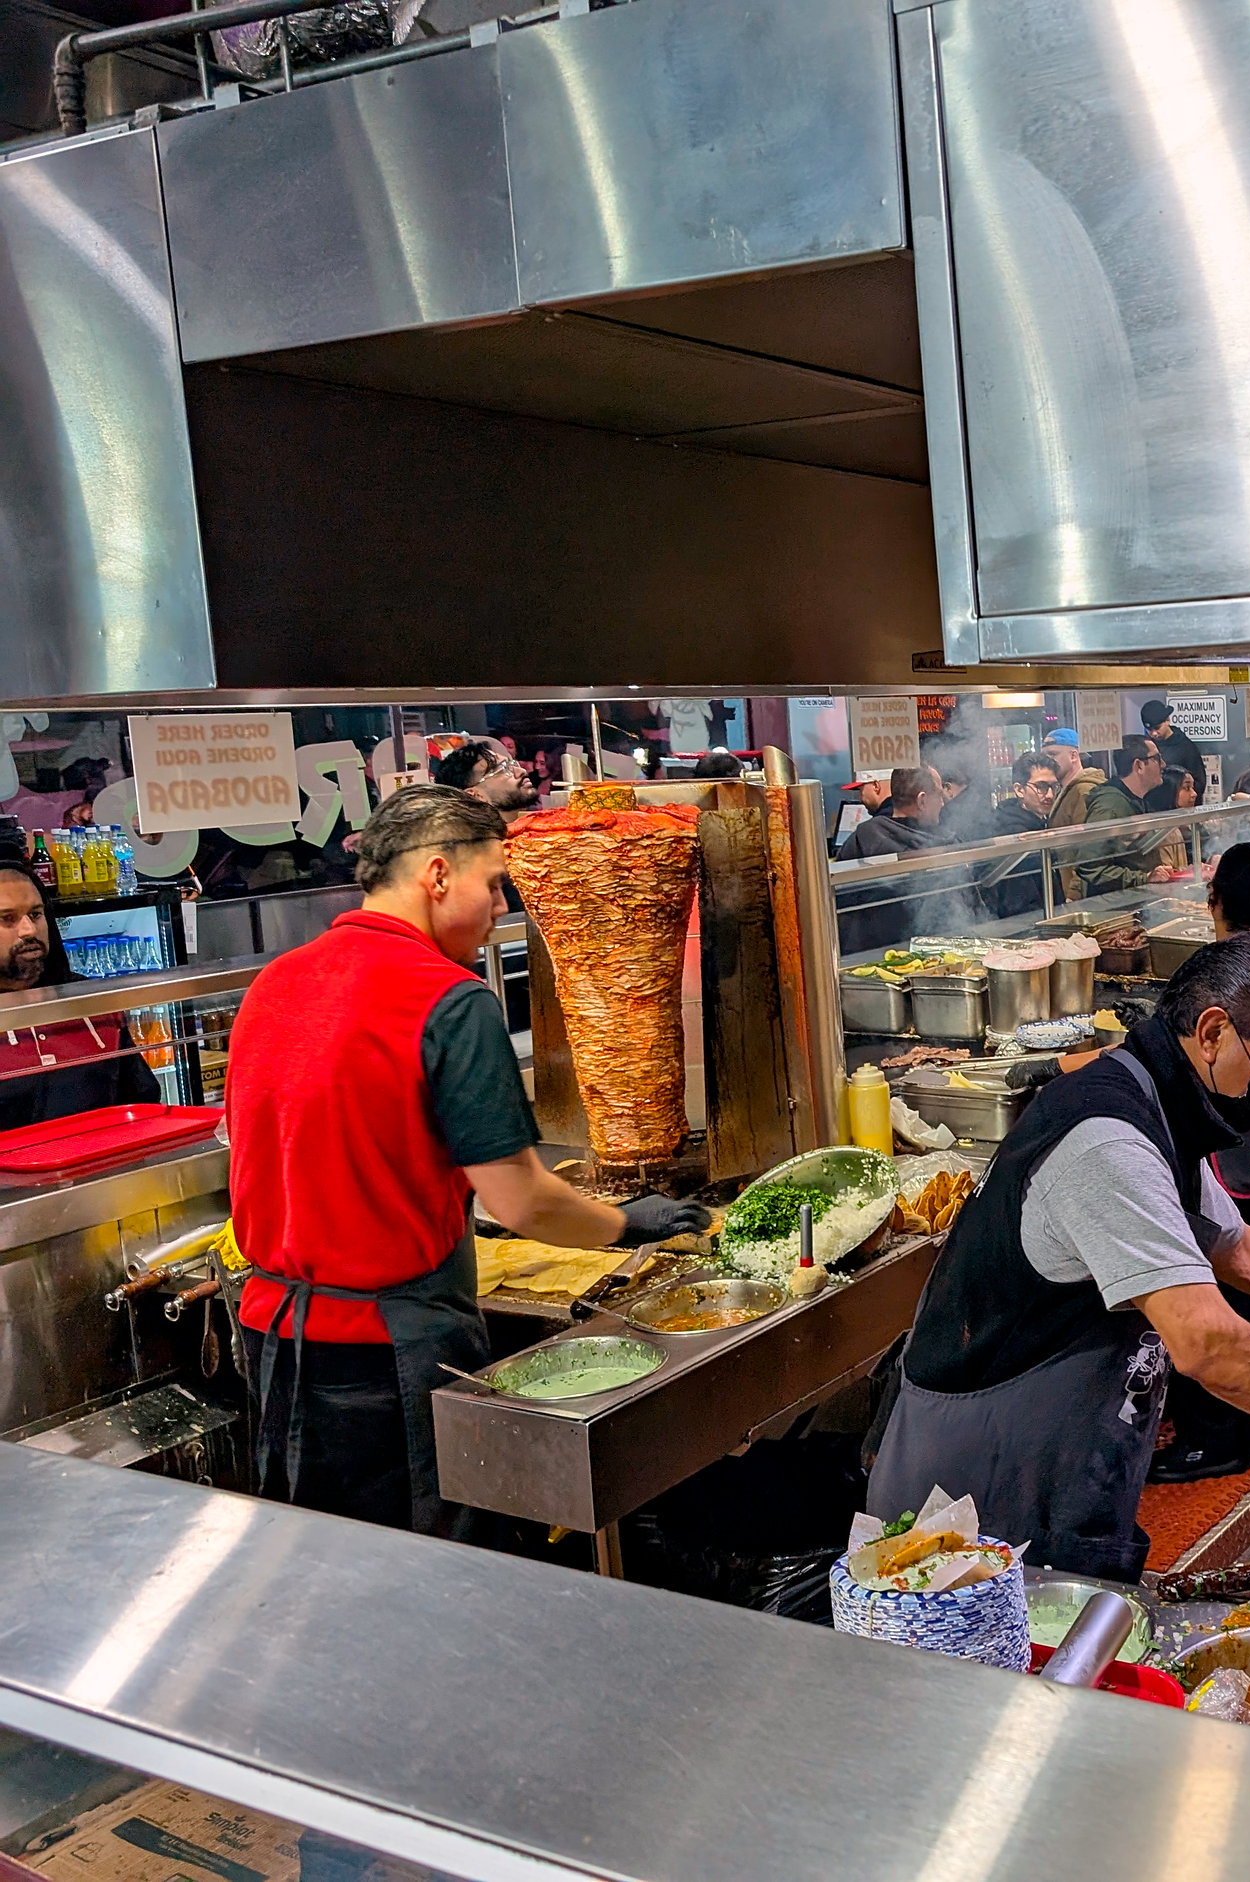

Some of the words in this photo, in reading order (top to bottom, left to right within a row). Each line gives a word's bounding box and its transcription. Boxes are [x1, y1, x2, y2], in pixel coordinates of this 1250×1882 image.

[1177, 702, 1216, 712] MAXIMUM
[1171, 714, 1222, 724] OCCUPANCY
[1183, 726, 1222, 736] PERSONS
[203, 1811, 255, 1839] Simplot
